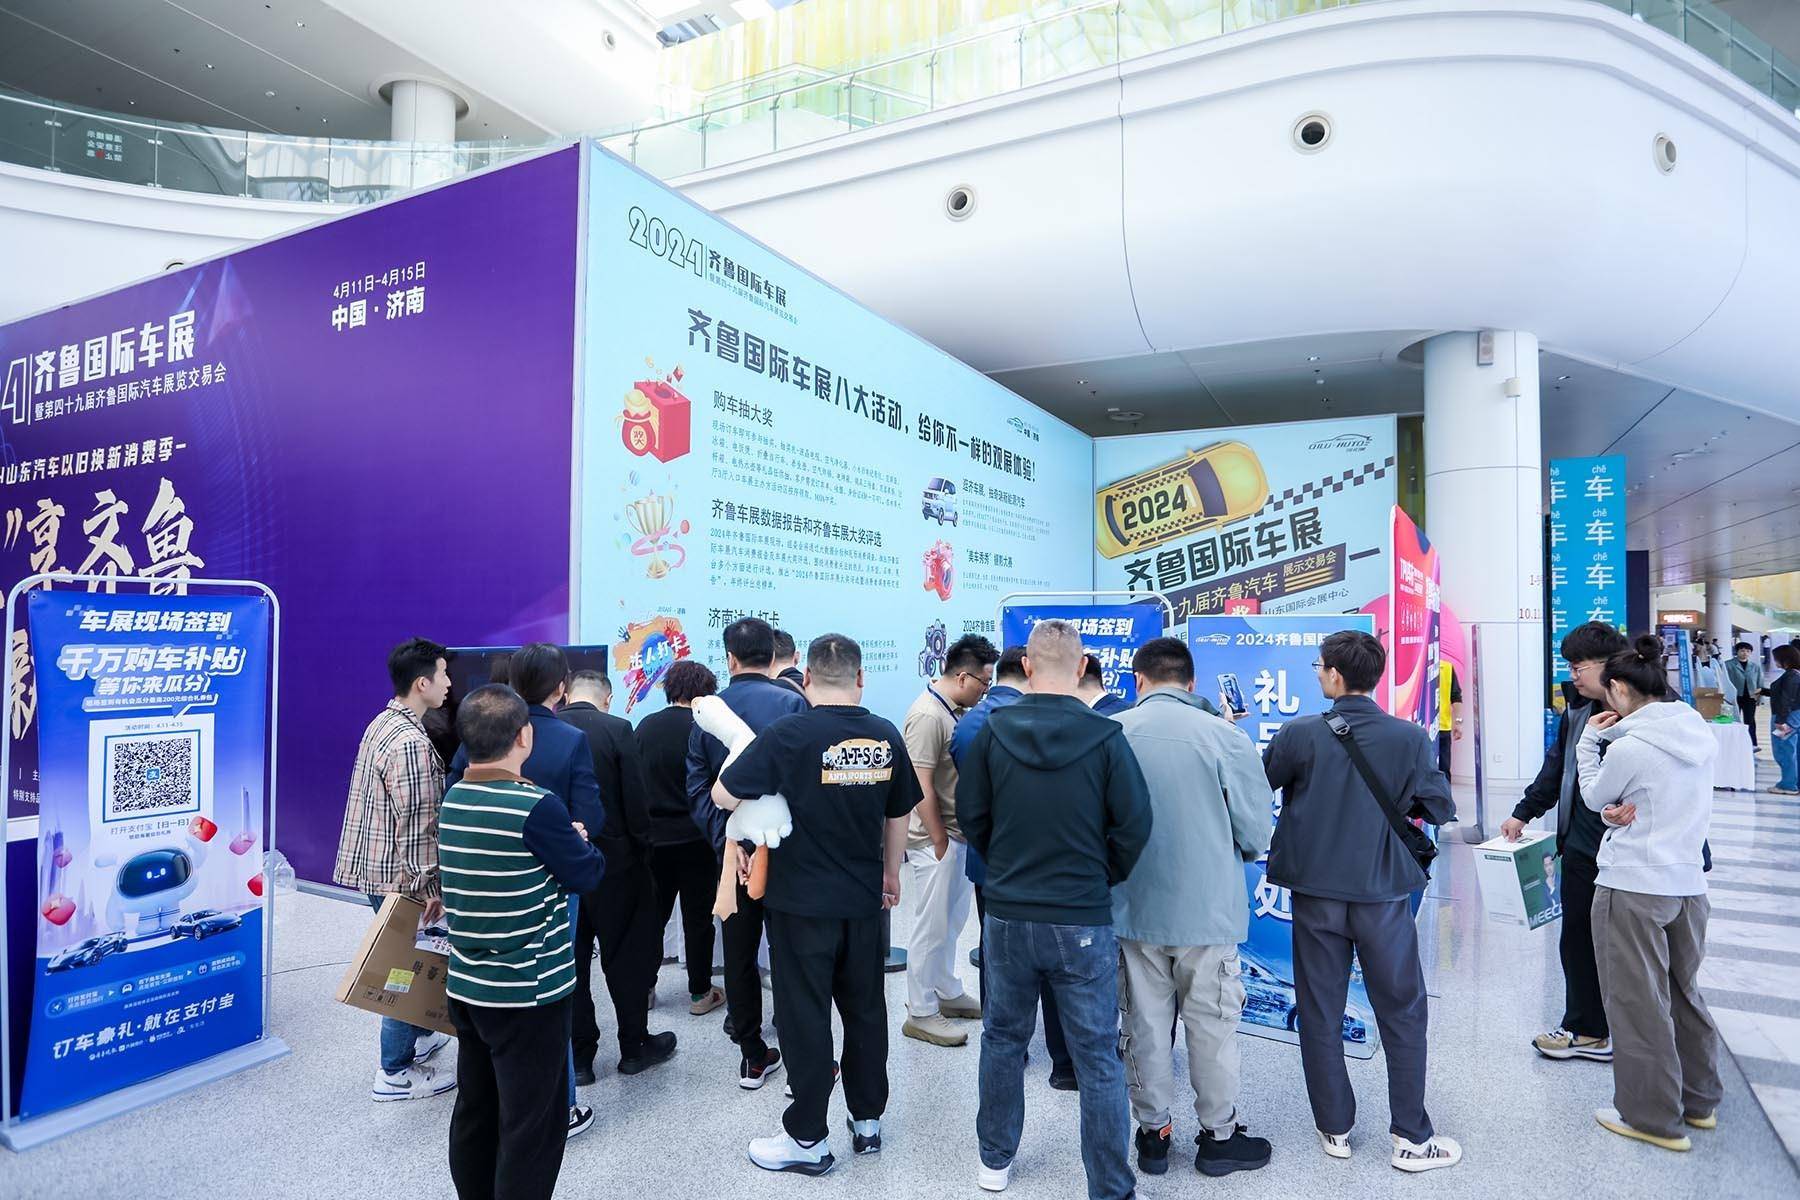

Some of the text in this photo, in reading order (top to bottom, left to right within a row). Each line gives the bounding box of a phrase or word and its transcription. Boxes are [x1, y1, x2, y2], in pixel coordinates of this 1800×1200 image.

[628, 206, 703, 278] 2024
[709, 249, 786, 307] 齐鲁国际车展
[34, 310, 196, 394] 齐鲁国际车展
[34, 361, 227, 421] 暨第四十九届齐鲁国际汽车展览交易会
[713, 390, 773, 428] 购车抽大奖
[1122, 485, 1188, 530] 2024
[1584, 475, 1614, 502] 车
[711, 499, 883, 547] 齐鲁车展数据报告和齐鲁车展大奖评选
[1585, 519, 1615, 546] 车
[1123, 506, 1324, 599] 齐鲁国际车展
[1283, 551, 1337, 577] 展示交易会
[1585, 563, 1615, 590] 车
[80, 609, 232, 632] 车展现场签到
[61, 646, 241, 675] 千万购车补贴
[98, 674, 204, 695] 等你来瓜分
